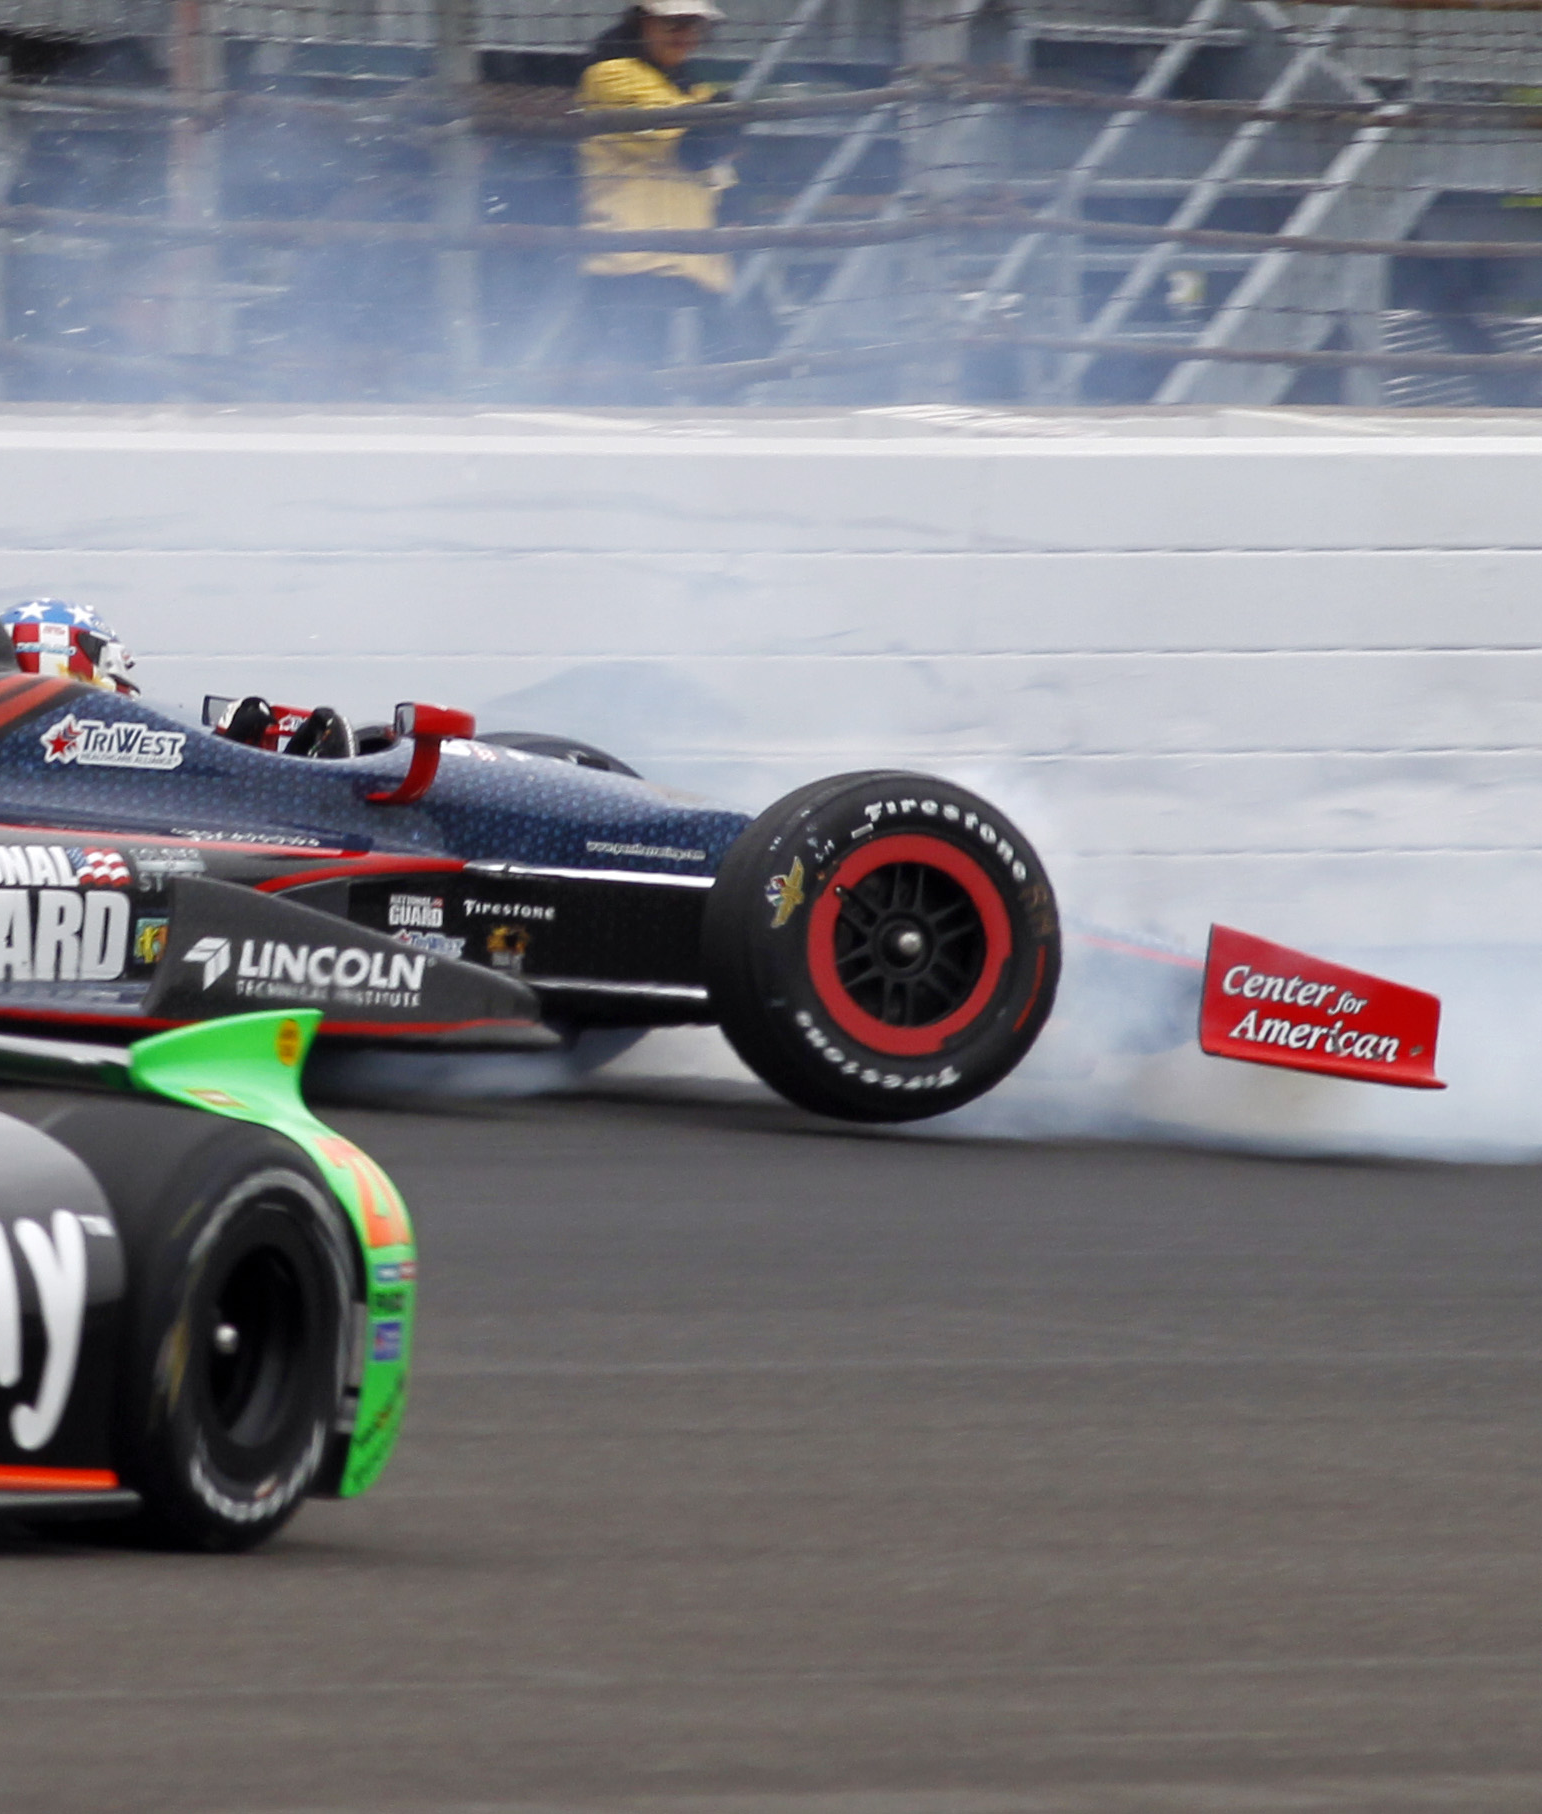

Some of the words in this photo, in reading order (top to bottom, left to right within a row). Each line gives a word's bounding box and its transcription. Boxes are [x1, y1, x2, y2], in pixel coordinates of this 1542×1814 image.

[864, 798, 1028, 883] Firestone
[388, 905, 444, 928] GUARD
[462, 899, 557, 921] Firestone
[237, 939, 427, 992] LINCOLN
[1222, 964, 1336, 1008] Center
[1326, 990, 1369, 1016] for
[1228, 1009, 1400, 1063] American
